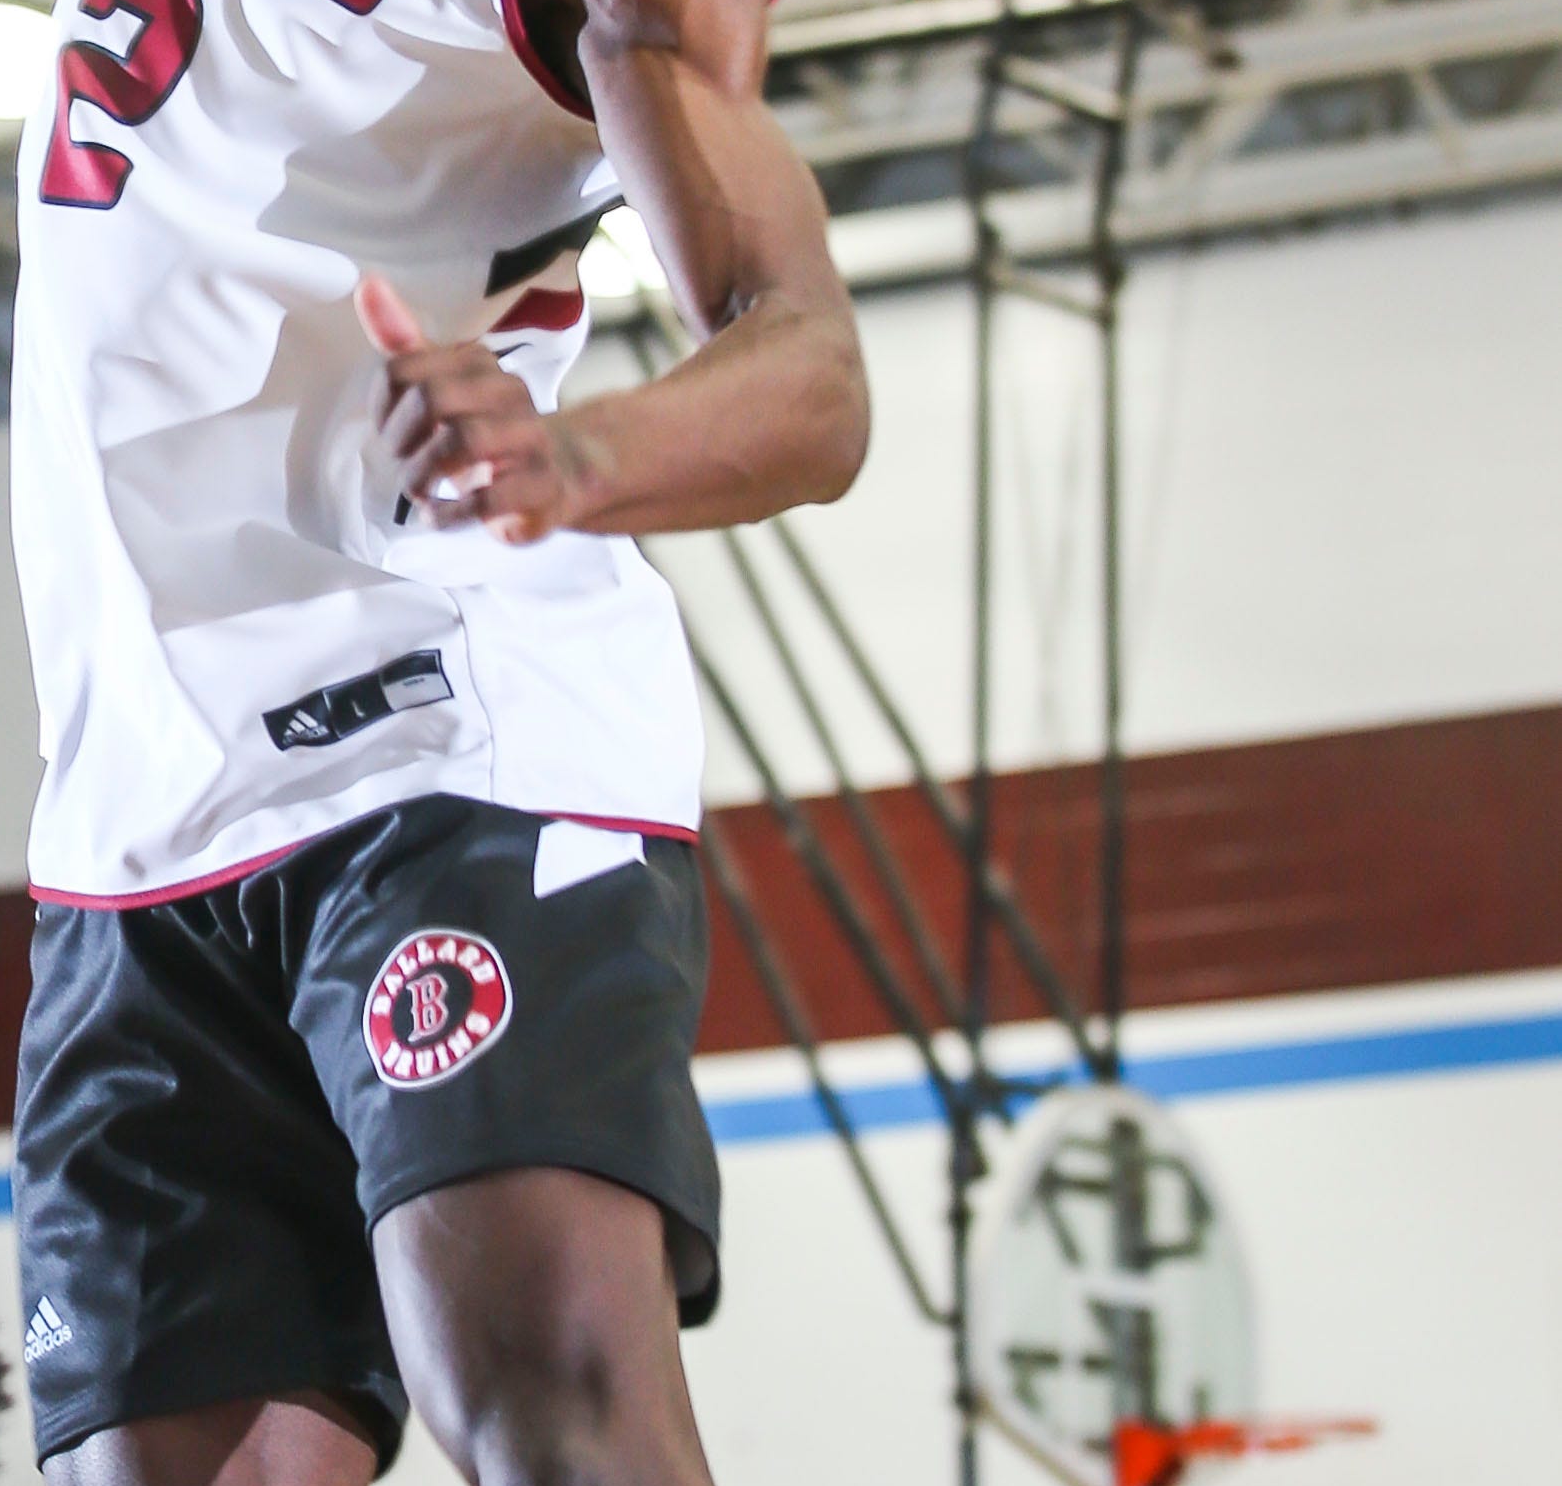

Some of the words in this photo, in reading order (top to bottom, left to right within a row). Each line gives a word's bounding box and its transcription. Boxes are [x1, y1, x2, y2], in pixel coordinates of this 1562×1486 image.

[372, 937, 496, 1015] BALLARD
[405, 971, 449, 1043] B
[382, 1011, 492, 1078] BRUINS
[23, 1323, 74, 1364] adidas
